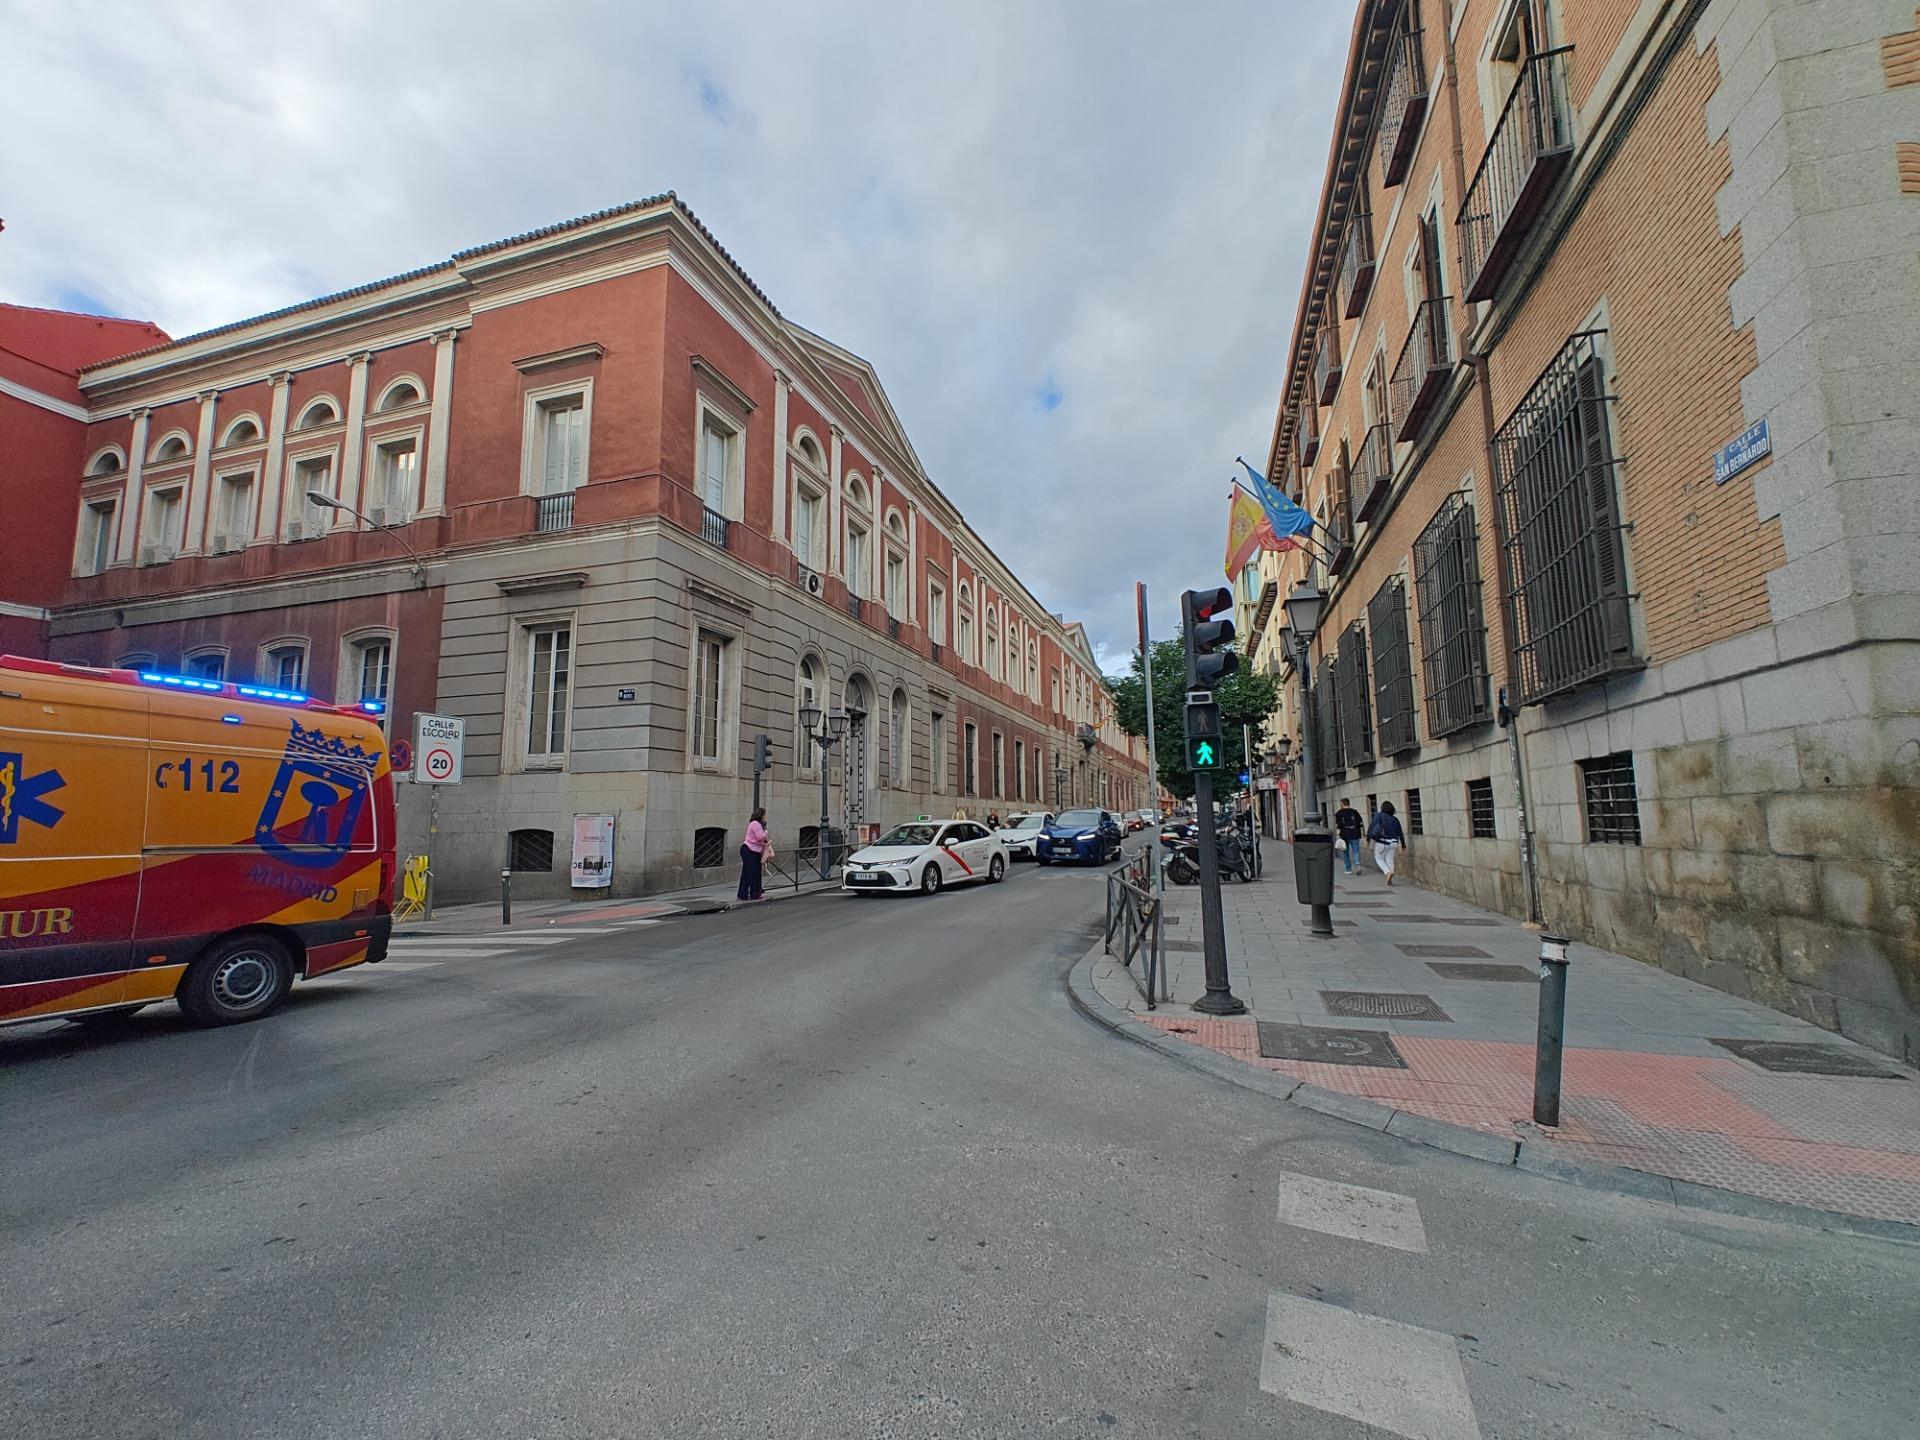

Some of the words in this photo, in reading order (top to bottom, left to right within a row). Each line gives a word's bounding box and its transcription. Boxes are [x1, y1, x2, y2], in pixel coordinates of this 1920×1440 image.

[1729, 426, 1761, 452] CALLE
[1716, 462, 1730, 481] SAN
[1730, 438, 1767, 472] BERNARDO
[422, 728, 461, 740] ESCOLAR
[178, 757, 240, 793] 112
[432, 759, 448, 769] 20
[0, 907, 74, 938] UR
